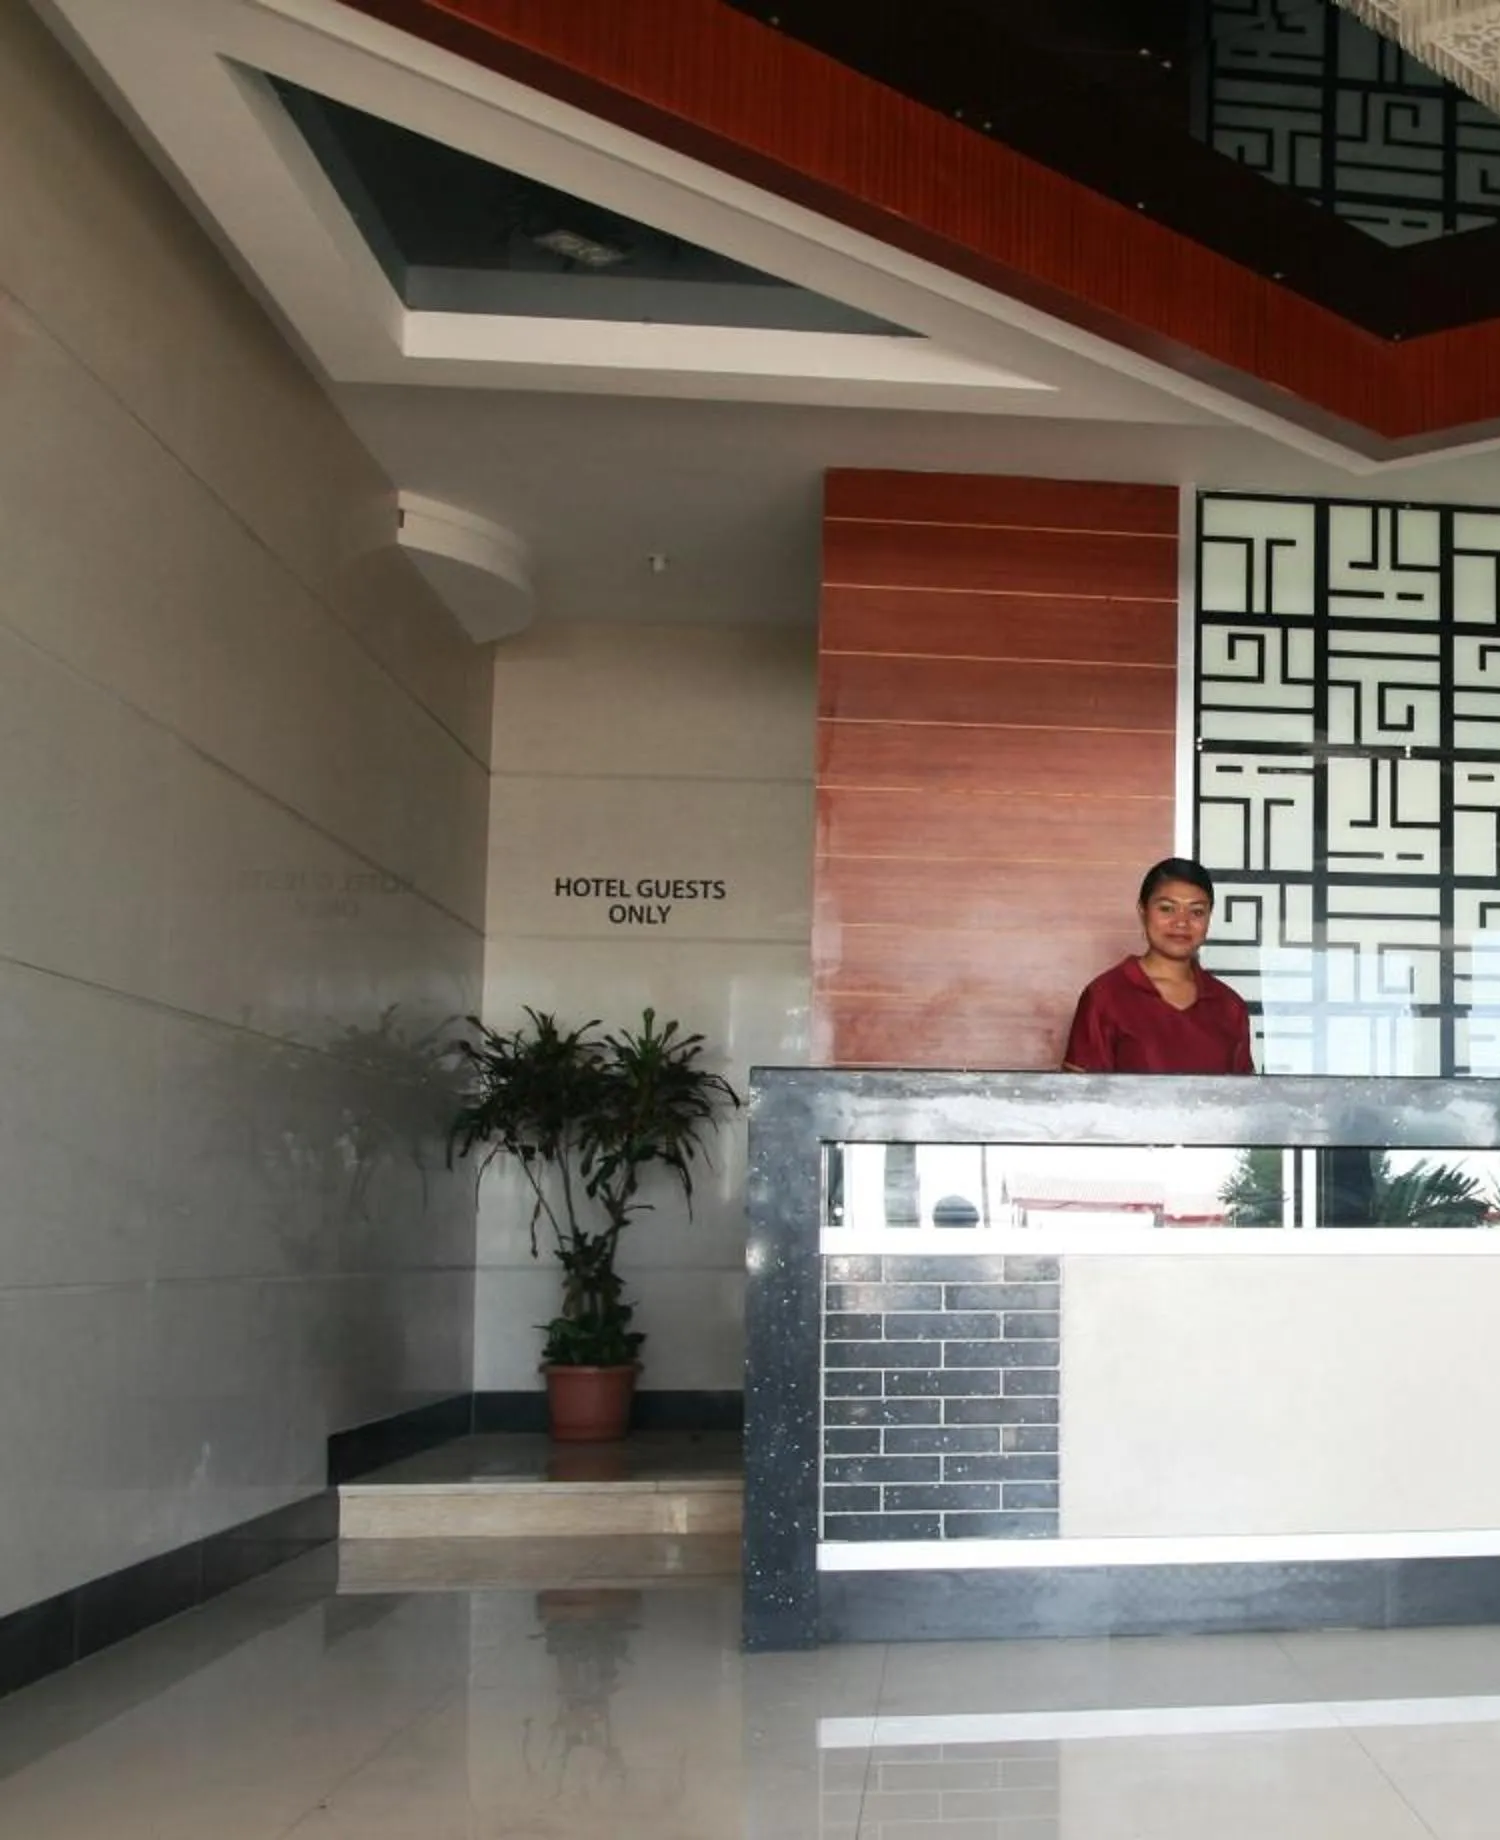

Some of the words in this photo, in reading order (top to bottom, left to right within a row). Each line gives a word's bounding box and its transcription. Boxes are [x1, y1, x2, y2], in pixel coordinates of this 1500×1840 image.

[555, 877, 631, 898] HOTEL
[636, 879, 726, 899] GUESTS
[609, 904, 671, 924] ONLY
